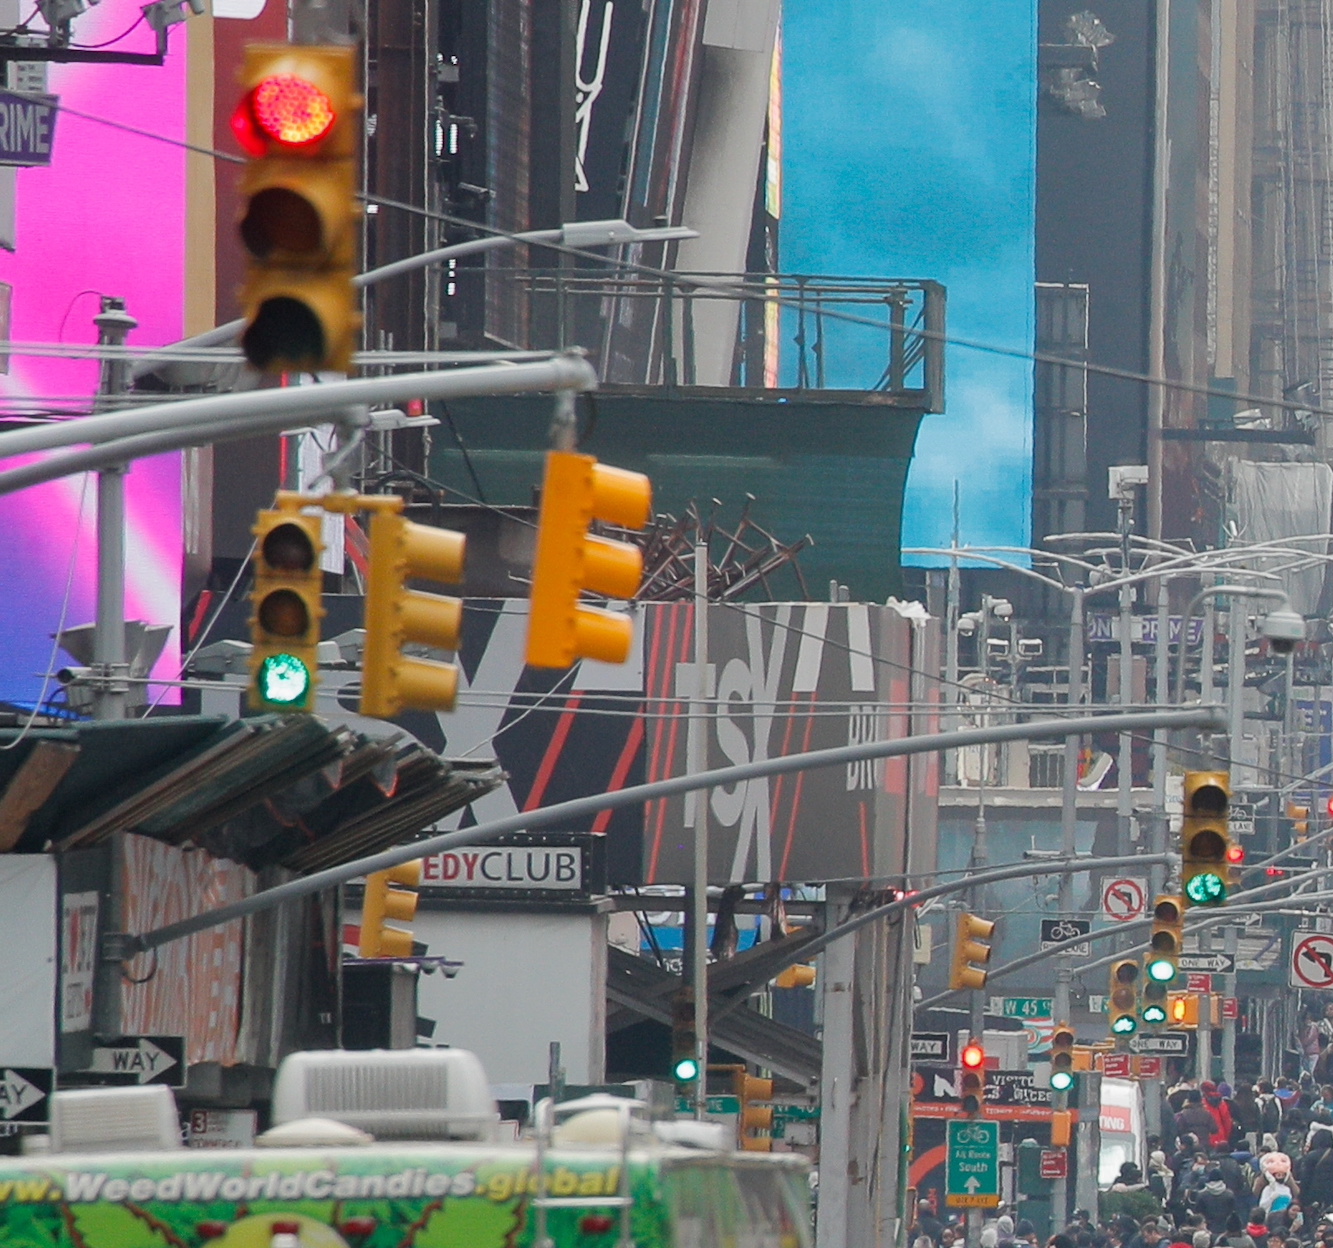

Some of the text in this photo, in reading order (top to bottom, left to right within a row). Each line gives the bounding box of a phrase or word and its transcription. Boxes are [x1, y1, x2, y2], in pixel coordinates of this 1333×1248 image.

[1142, 621, 1198, 643] PRME
[1207, 958, 1226, 968] WAY
[1004, 1000, 1038, 1016] W 45
[1157, 1039, 1179, 1050] WAY
[112, 1050, 161, 1072] WAY
[194, 1113, 206, 1132] 3
[959, 1162, 989, 1173] South
